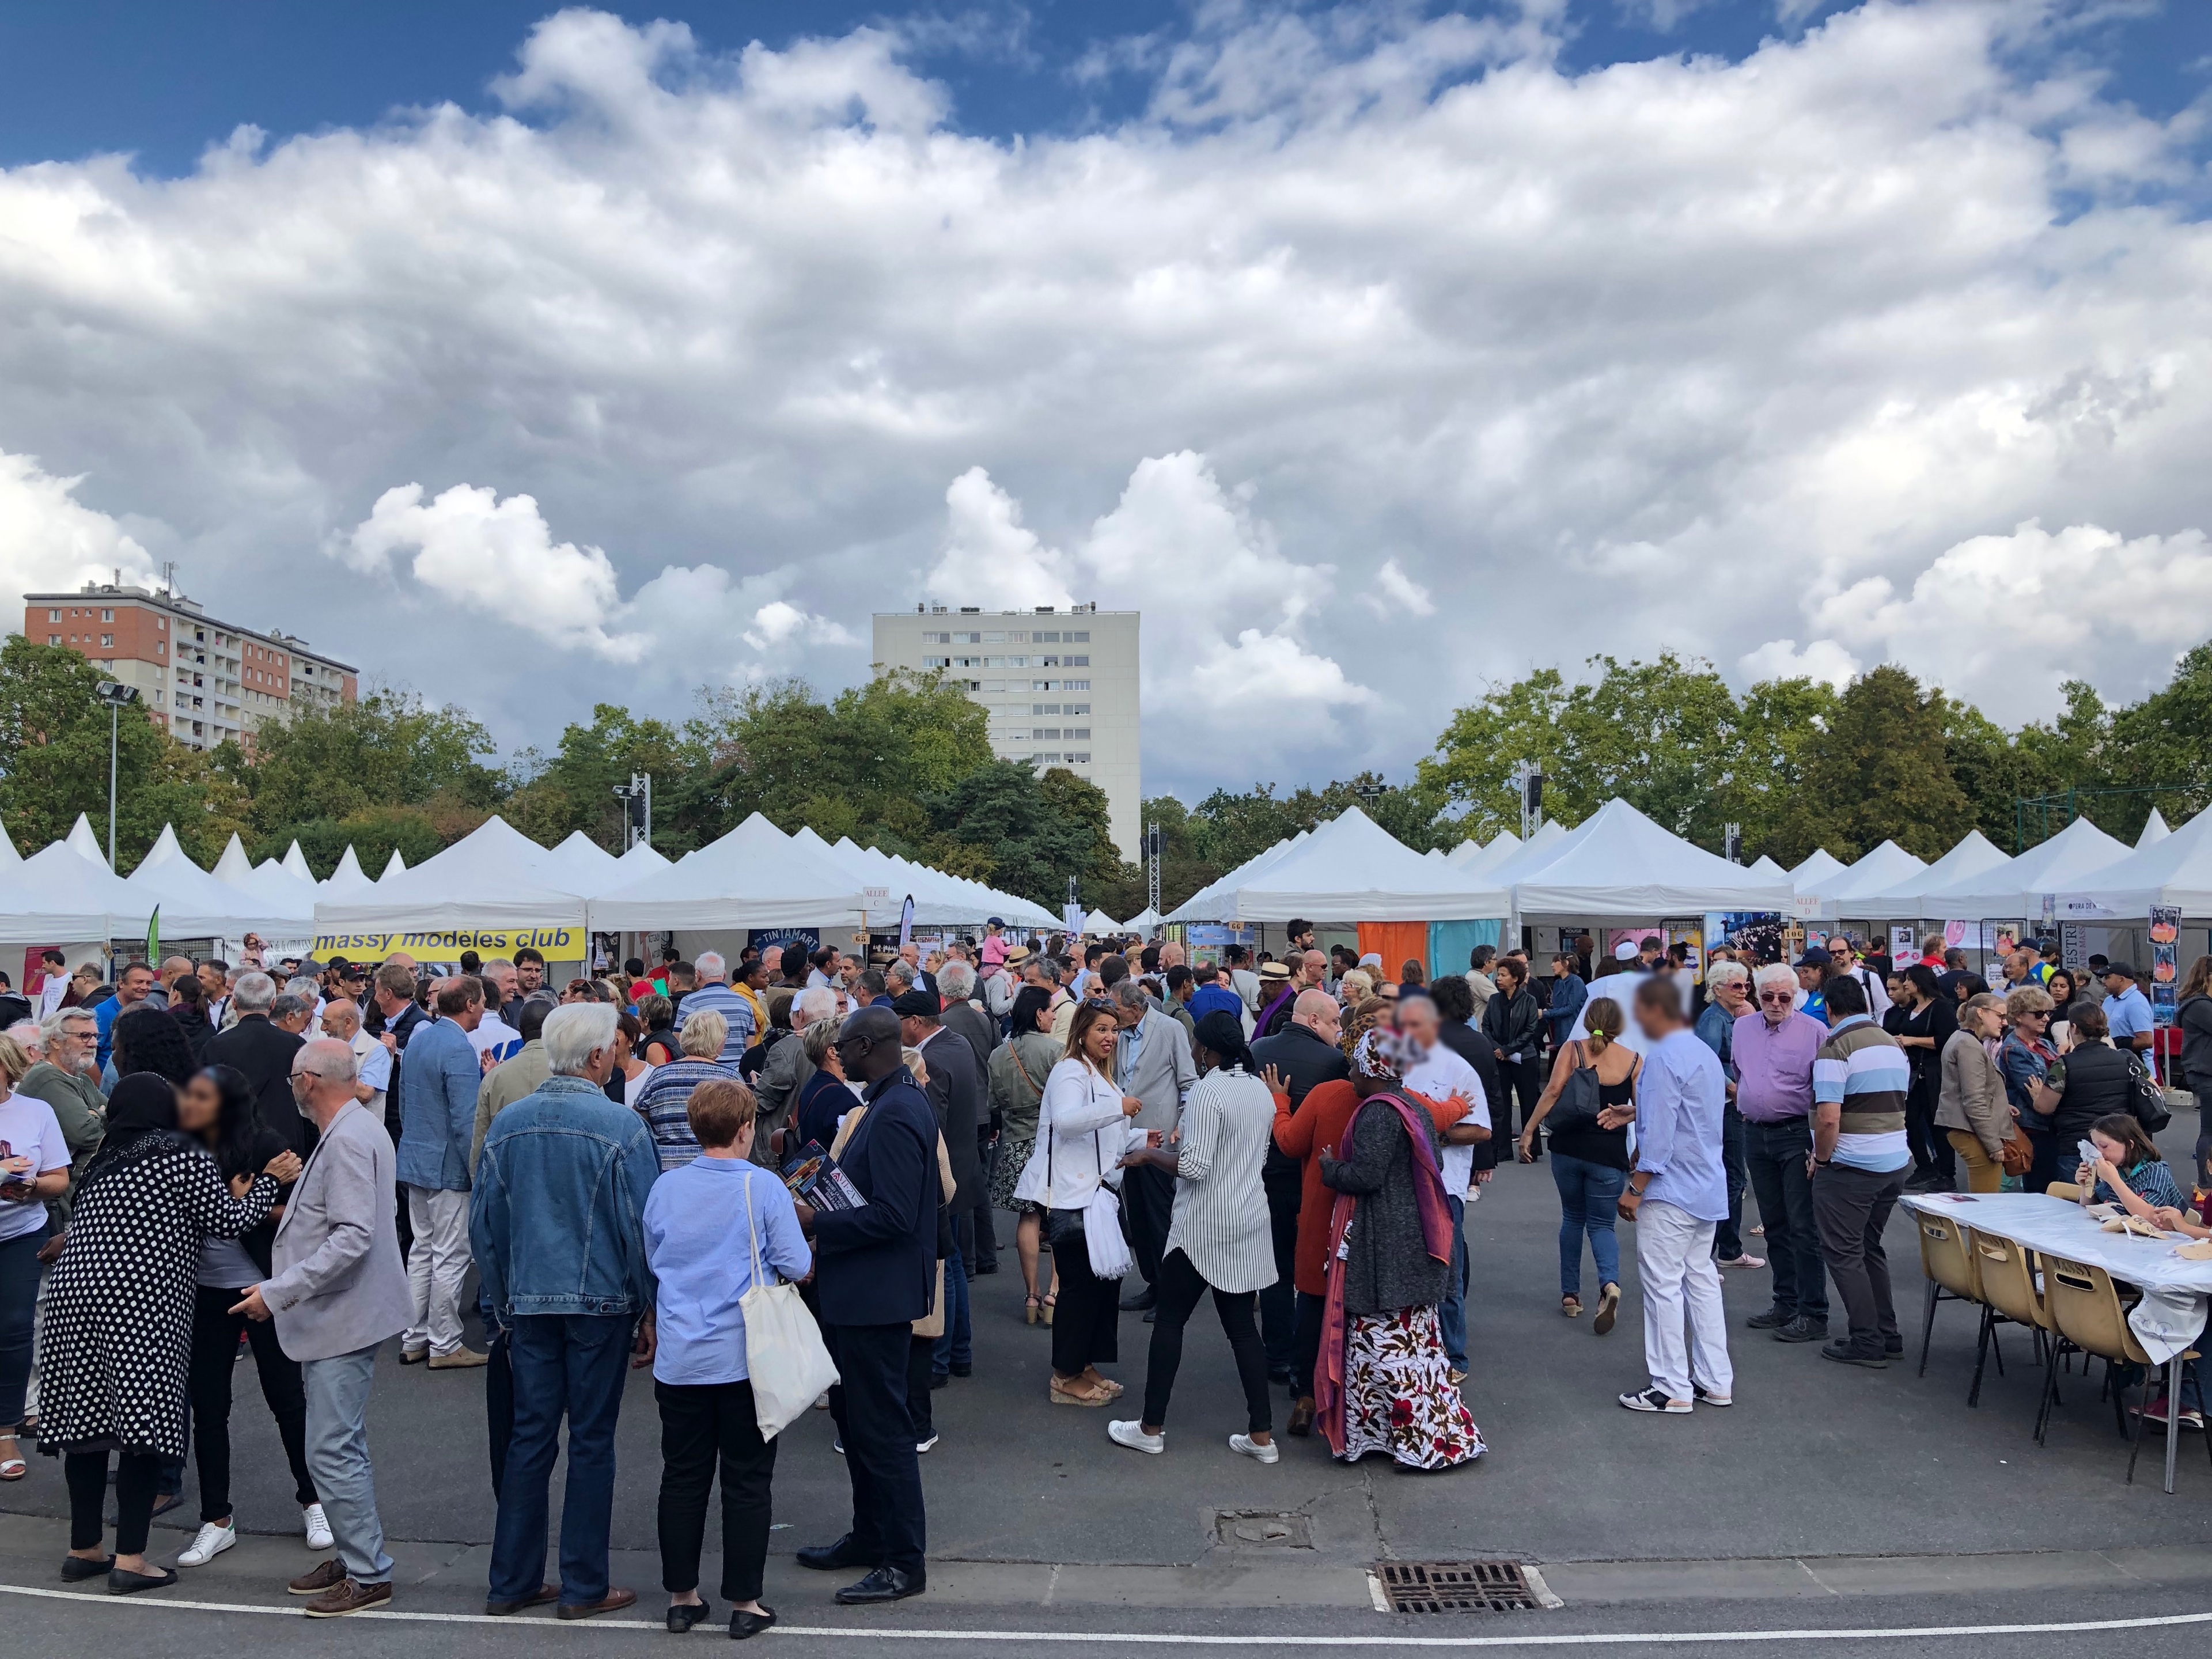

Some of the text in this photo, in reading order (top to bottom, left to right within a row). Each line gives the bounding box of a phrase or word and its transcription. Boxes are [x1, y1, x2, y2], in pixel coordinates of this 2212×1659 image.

[315, 928, 570, 952] massy modèles club
[2065, 923, 2078, 970] ESTRE
